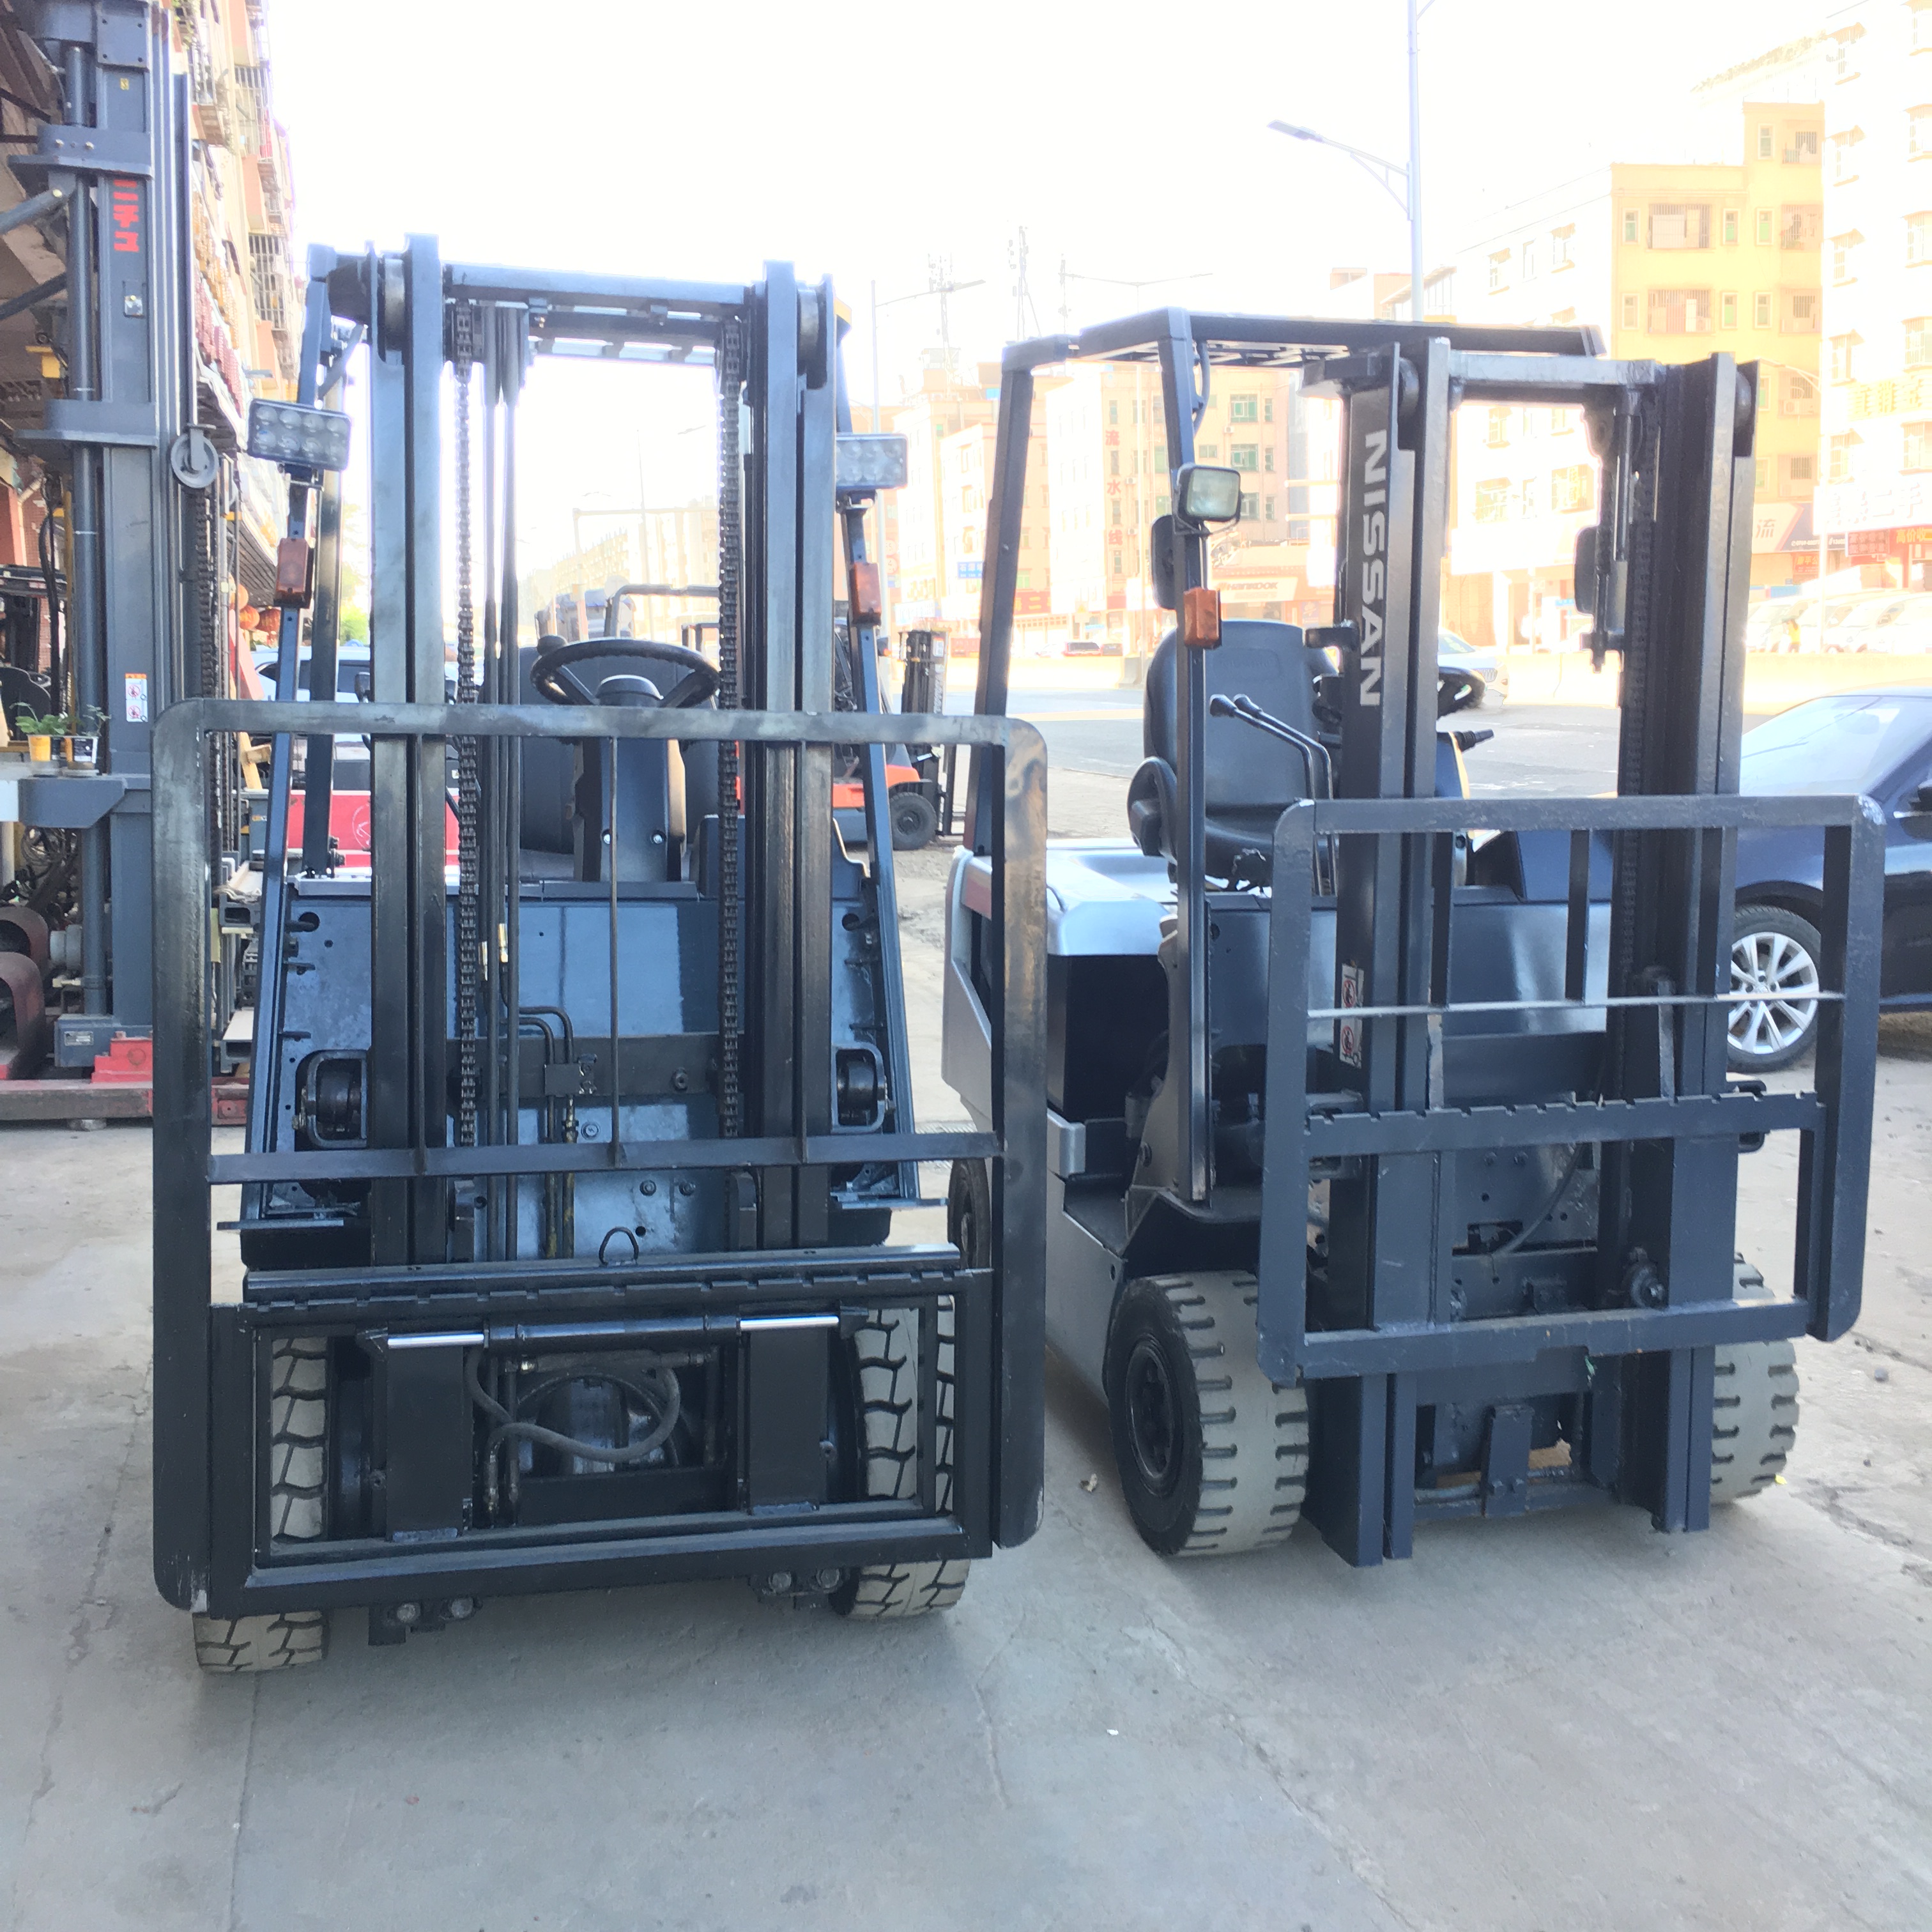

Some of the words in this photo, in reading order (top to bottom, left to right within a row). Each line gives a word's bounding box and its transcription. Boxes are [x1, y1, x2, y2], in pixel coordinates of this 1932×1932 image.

[1105, 430, 1123, 546] 流水线
[1360, 431, 1387, 707] NISSAN
